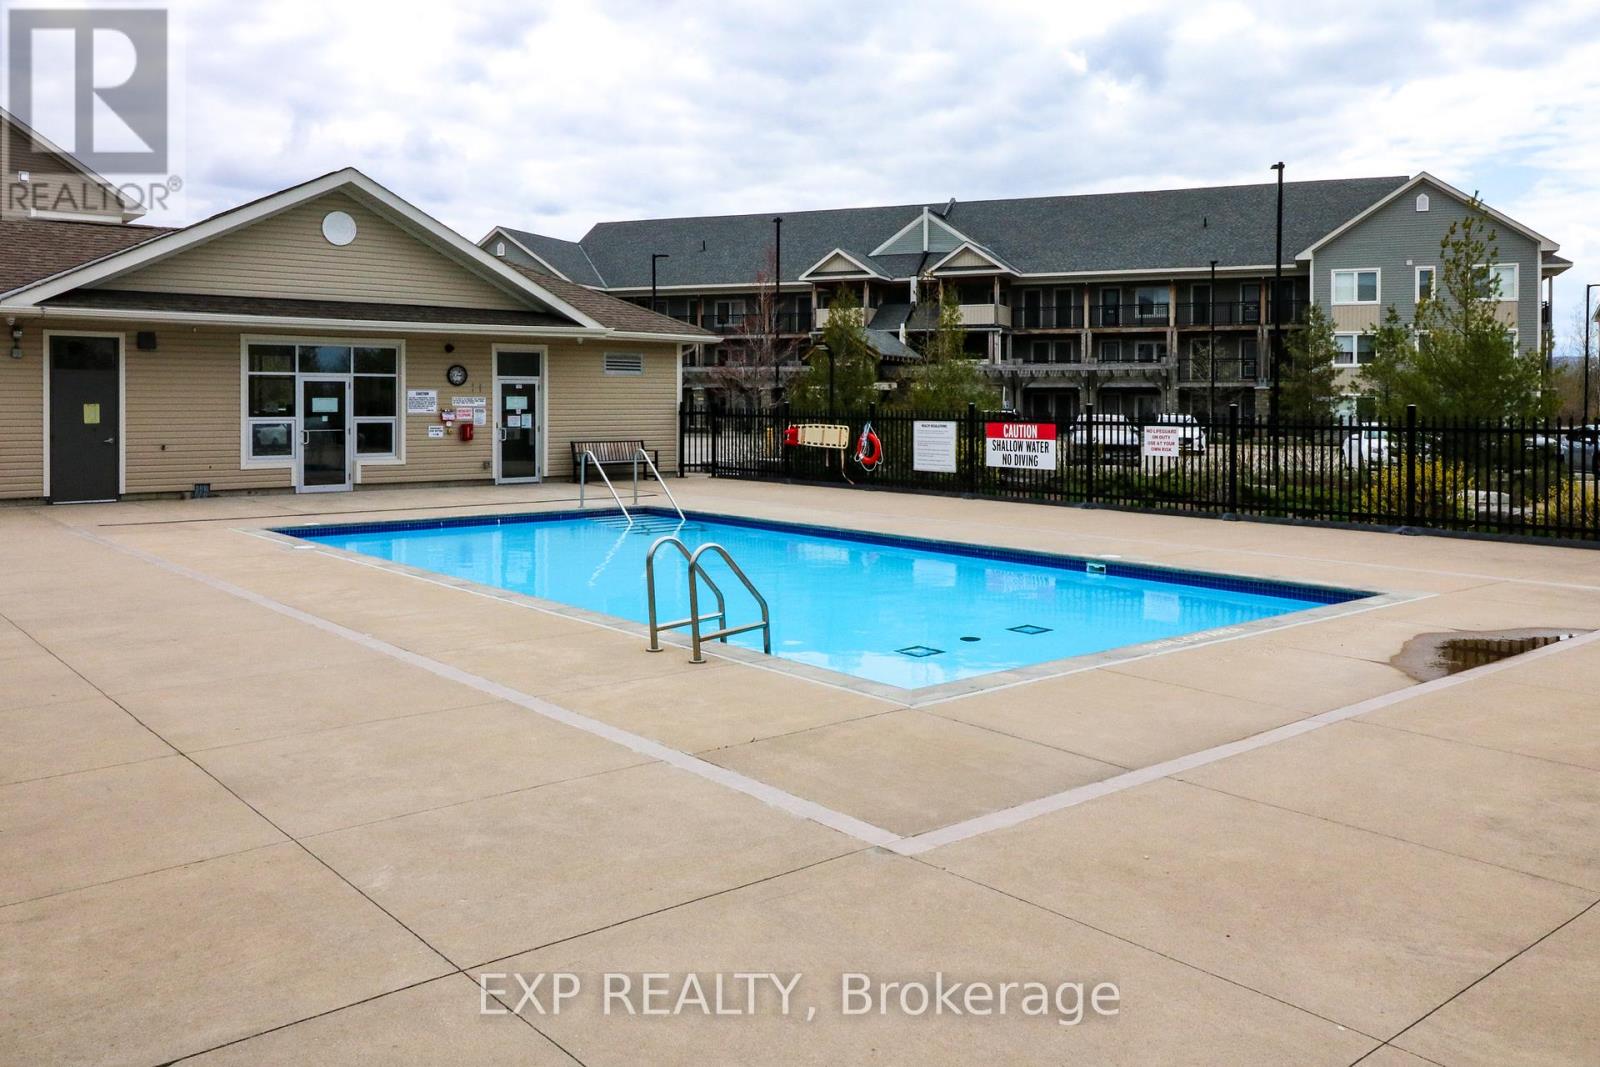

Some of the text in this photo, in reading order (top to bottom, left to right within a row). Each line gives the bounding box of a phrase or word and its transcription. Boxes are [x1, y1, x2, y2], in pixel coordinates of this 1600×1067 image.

[1003, 424, 1037, 438] CAUTION
[992, 440, 1050, 453] SHALLOW WATER
[1002, 453, 1039, 467] NO DIVING
